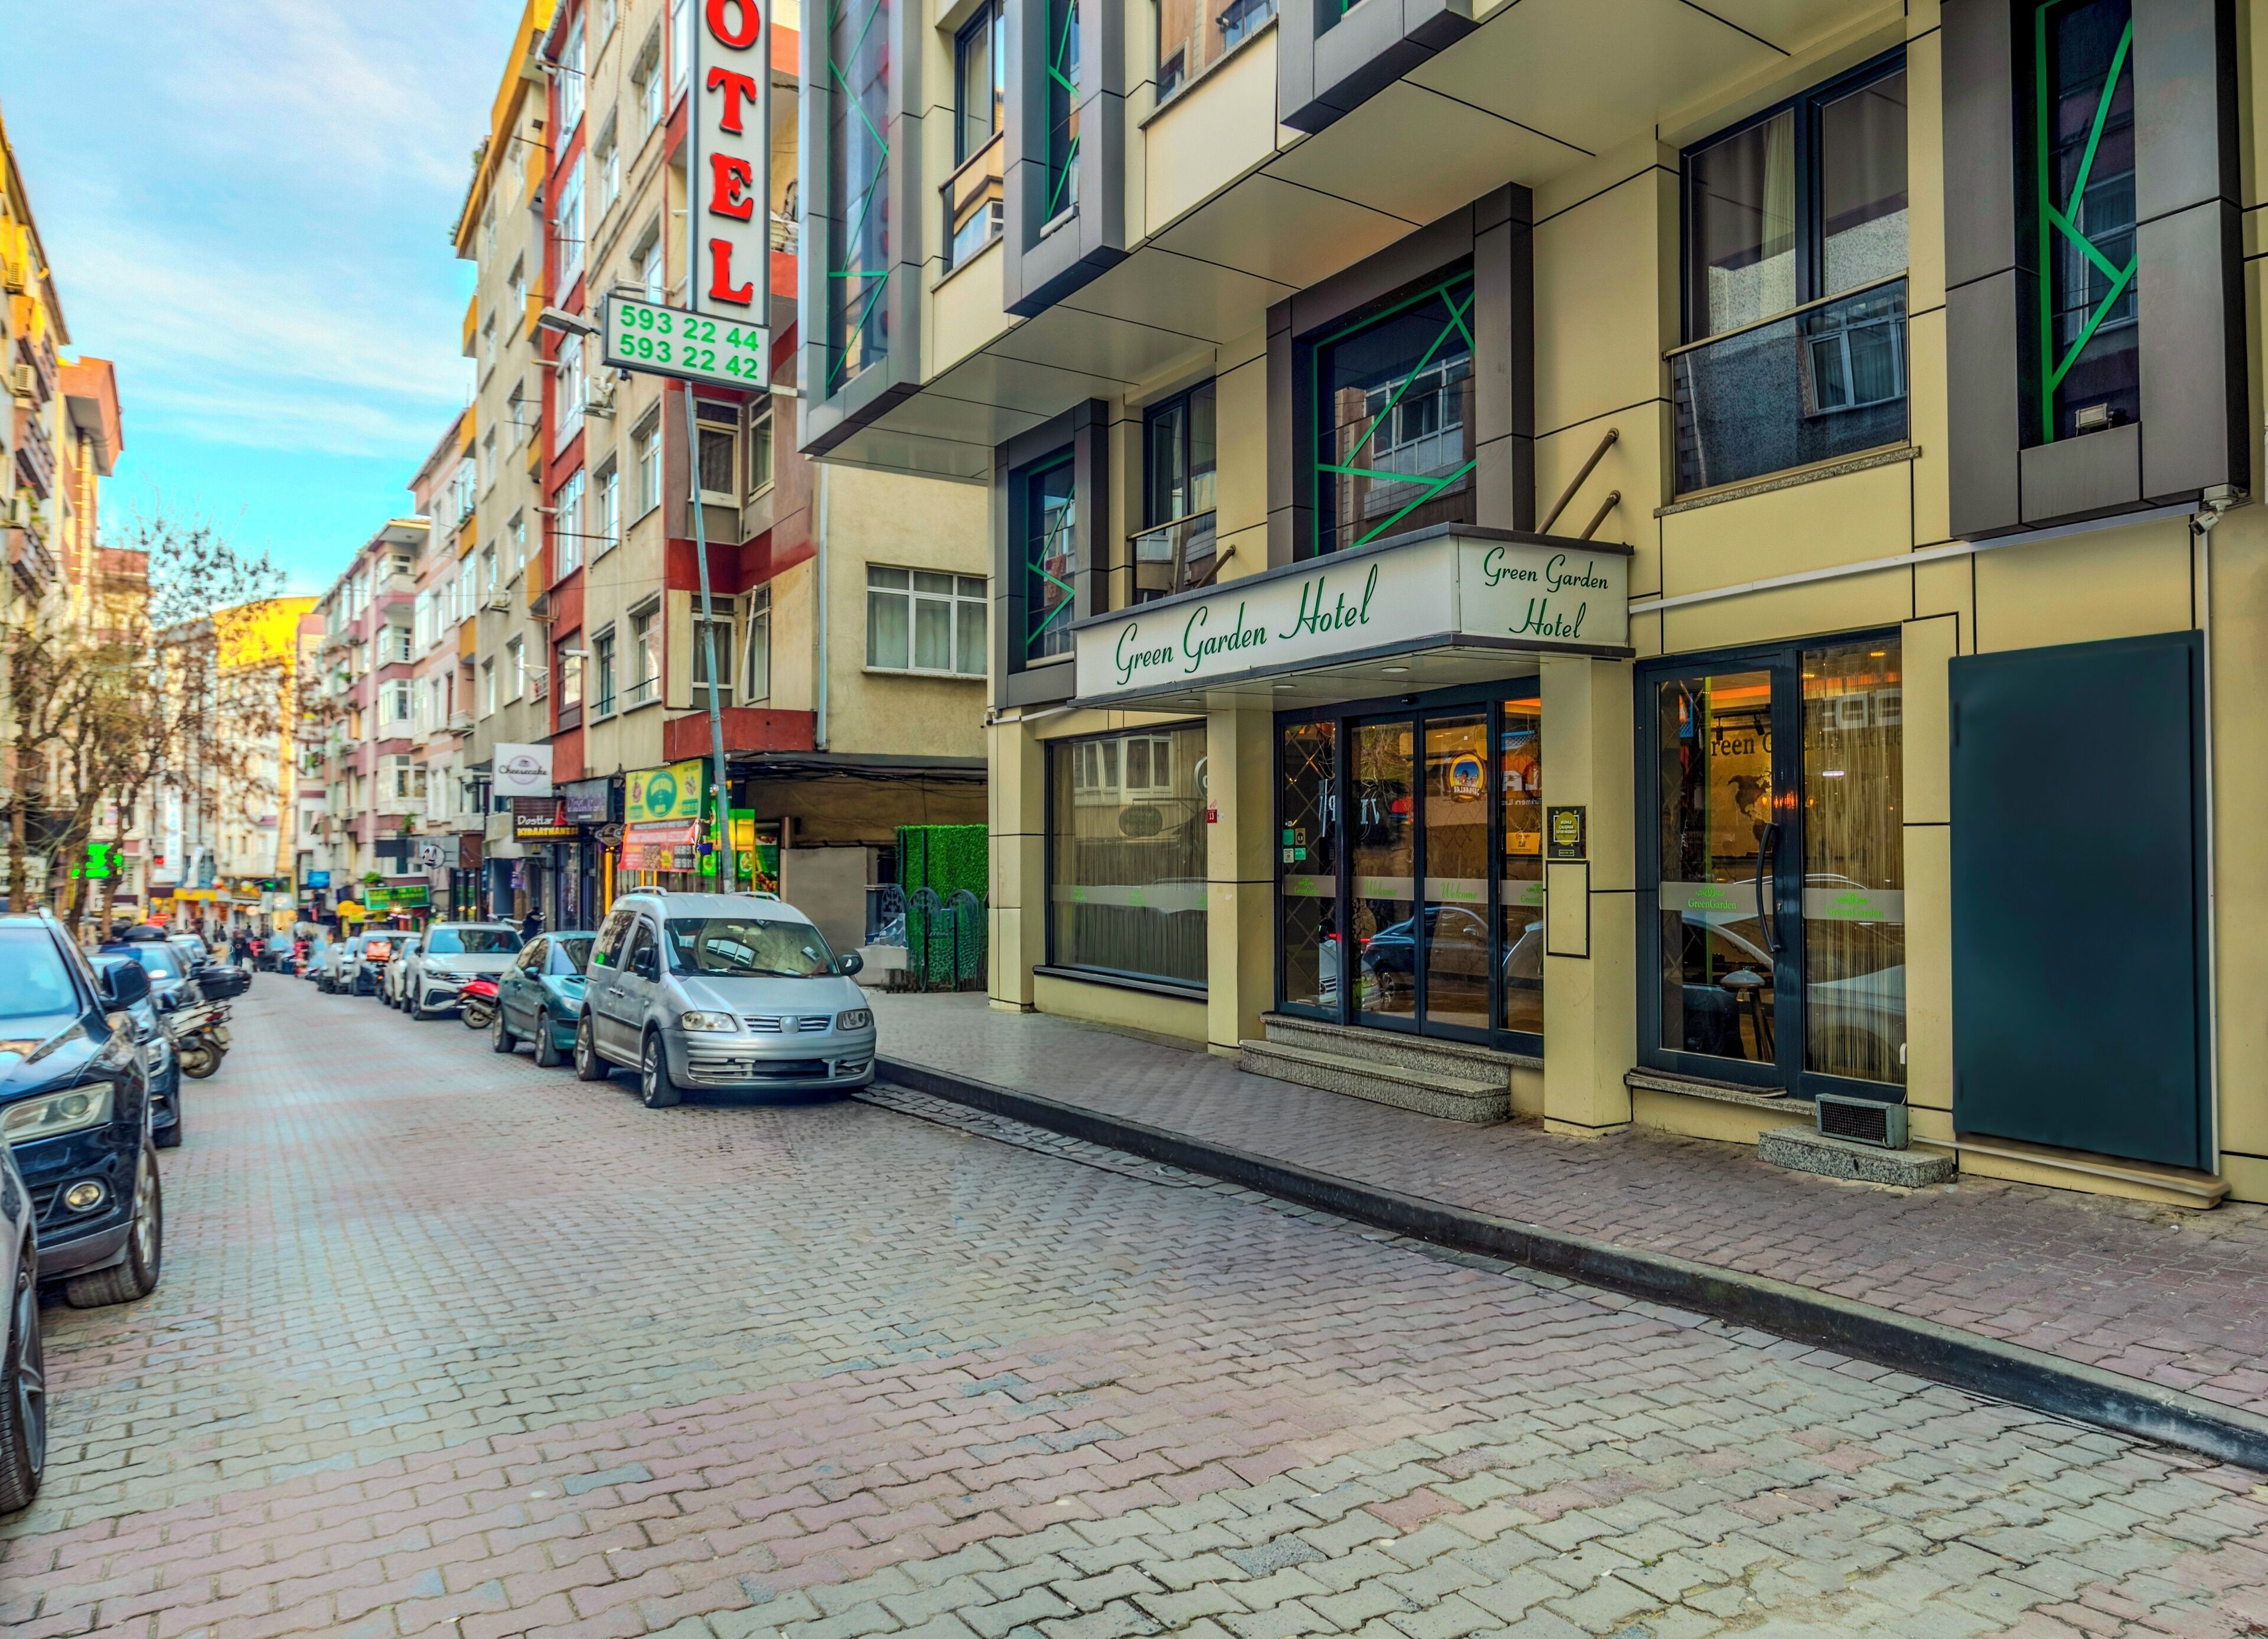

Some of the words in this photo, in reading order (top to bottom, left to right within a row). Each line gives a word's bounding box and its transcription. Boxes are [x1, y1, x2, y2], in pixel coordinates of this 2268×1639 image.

[620, 305, 672, 334] 593
[683, 318, 715, 343] 22
[726, 328, 758, 351] 44
[620, 334, 672, 363] 593
[683, 347, 715, 372] 22
[725, 356, 757, 379] 42
[1484, 547, 1538, 586] Green
[1546, 554, 1608, 593] Garden
[1116, 623, 1174, 686] Green
[1184, 601, 1267, 674] Garden
[1279, 563, 1377, 640] Hotel
[1508, 598, 1586, 638] Hotel
[499, 765, 548, 775] Cheesecake
[517, 816, 554, 825] Dostlar
[1365, 878, 1397, 897] Welcome
[1441, 881, 1478, 900] Welcome
[1688, 898, 1736, 910] GreenGarden
[1825, 905, 1884, 919] GreenGarden
